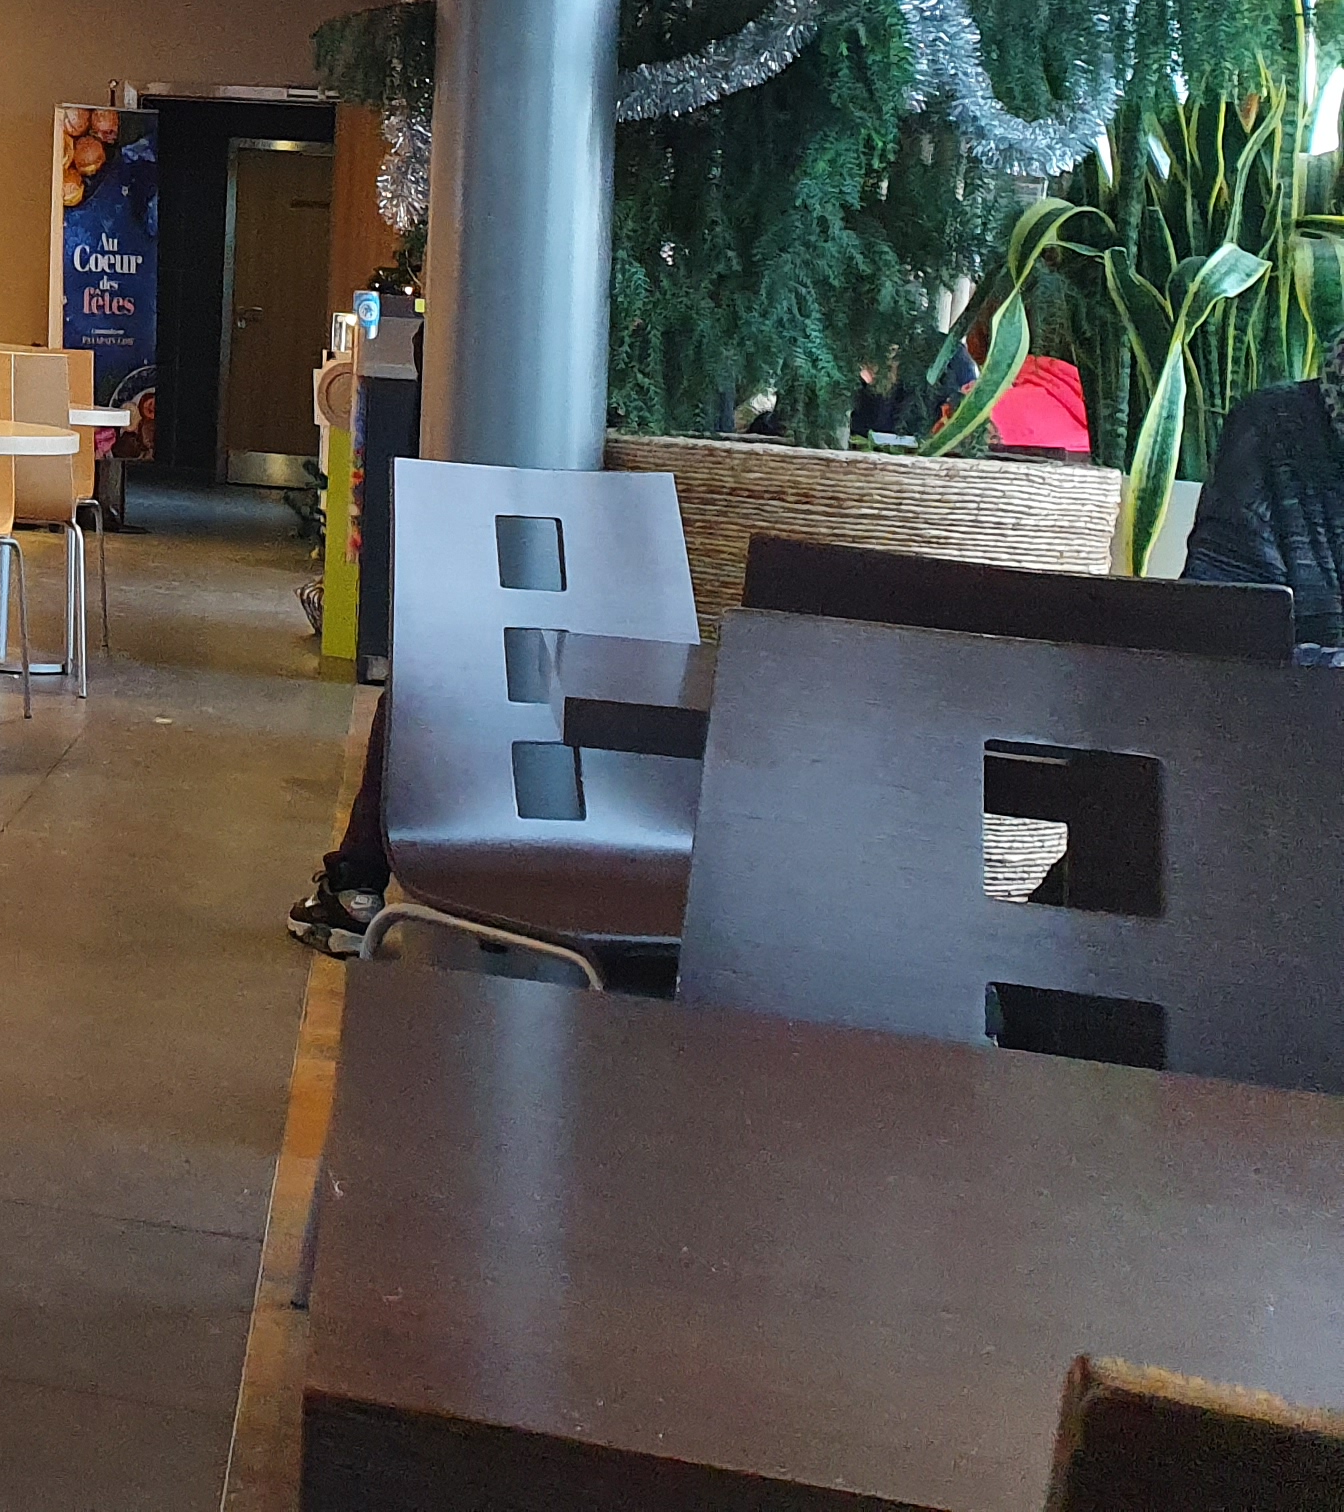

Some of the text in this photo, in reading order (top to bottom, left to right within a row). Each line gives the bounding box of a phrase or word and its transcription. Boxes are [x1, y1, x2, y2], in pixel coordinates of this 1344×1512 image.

[97, 232, 118, 251] Au
[73, 244, 143, 274] Coeur
[83, 286, 135, 316] fêtes
